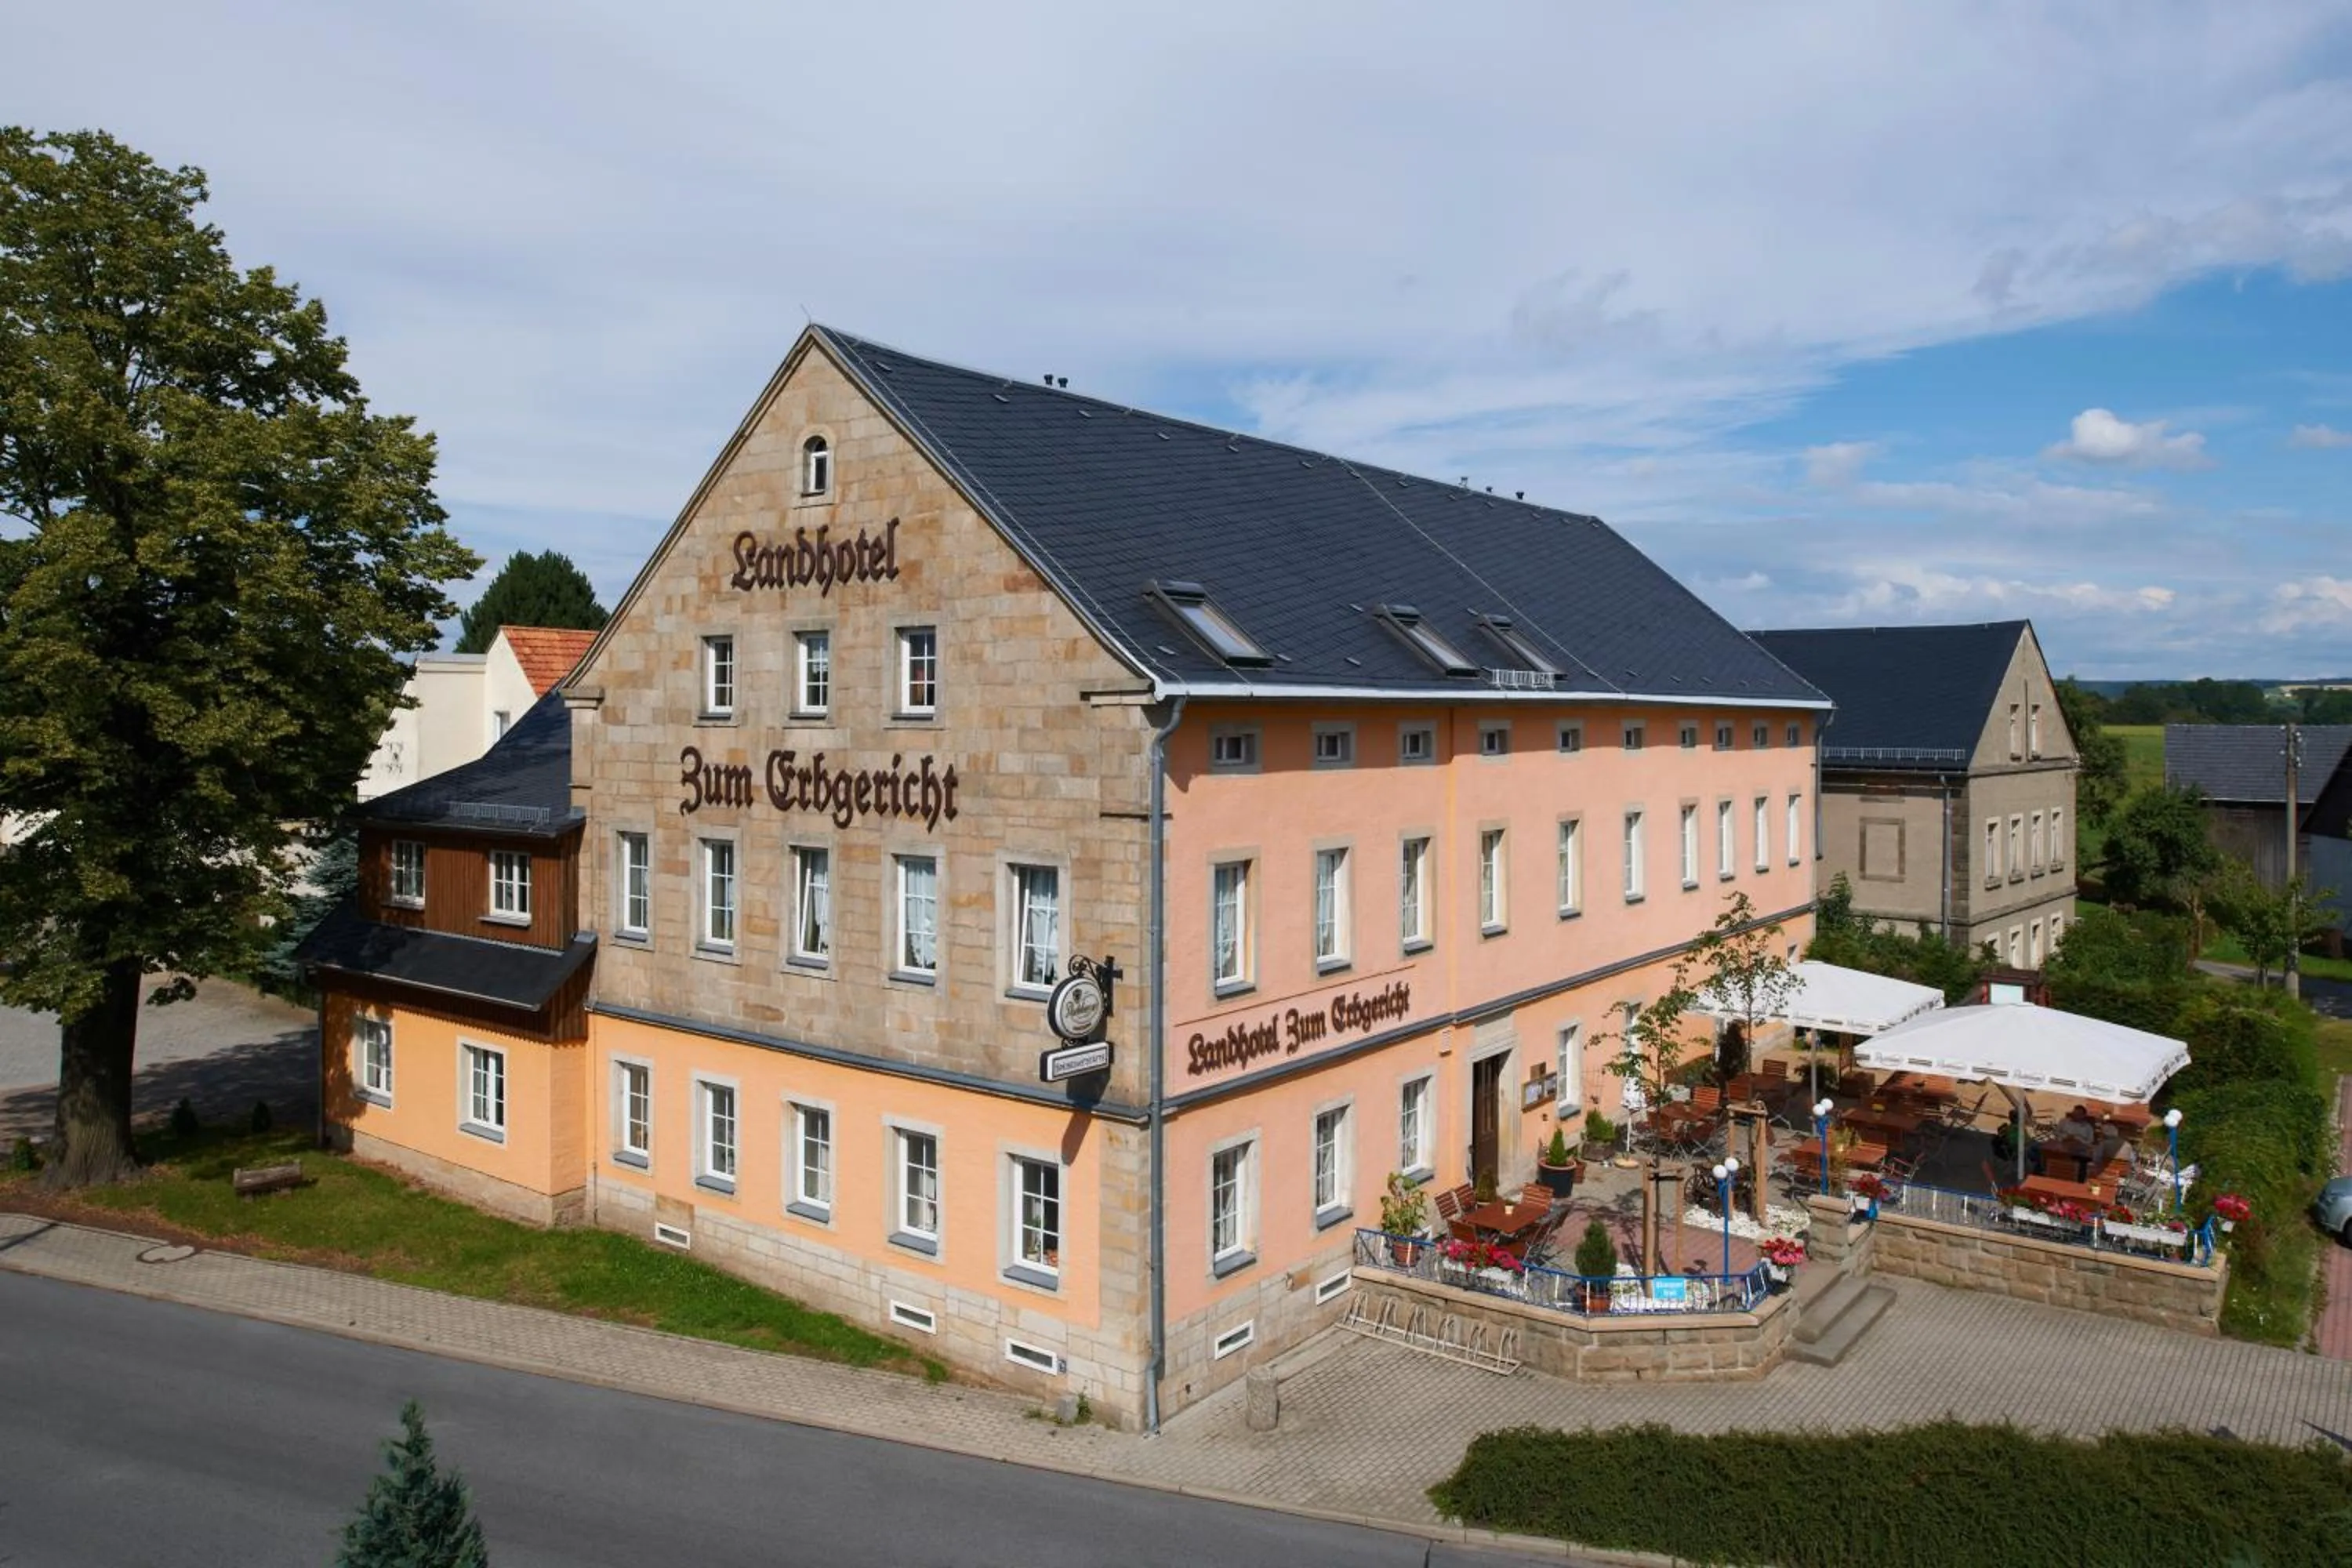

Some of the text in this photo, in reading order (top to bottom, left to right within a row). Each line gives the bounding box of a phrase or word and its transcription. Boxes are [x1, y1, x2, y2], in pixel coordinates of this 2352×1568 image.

[731, 517, 899, 598] Landhotel
[679, 746, 960, 834] Zum Erbgericht
[1187, 981, 1410, 1076] Landhotel Zum Erbgericht
